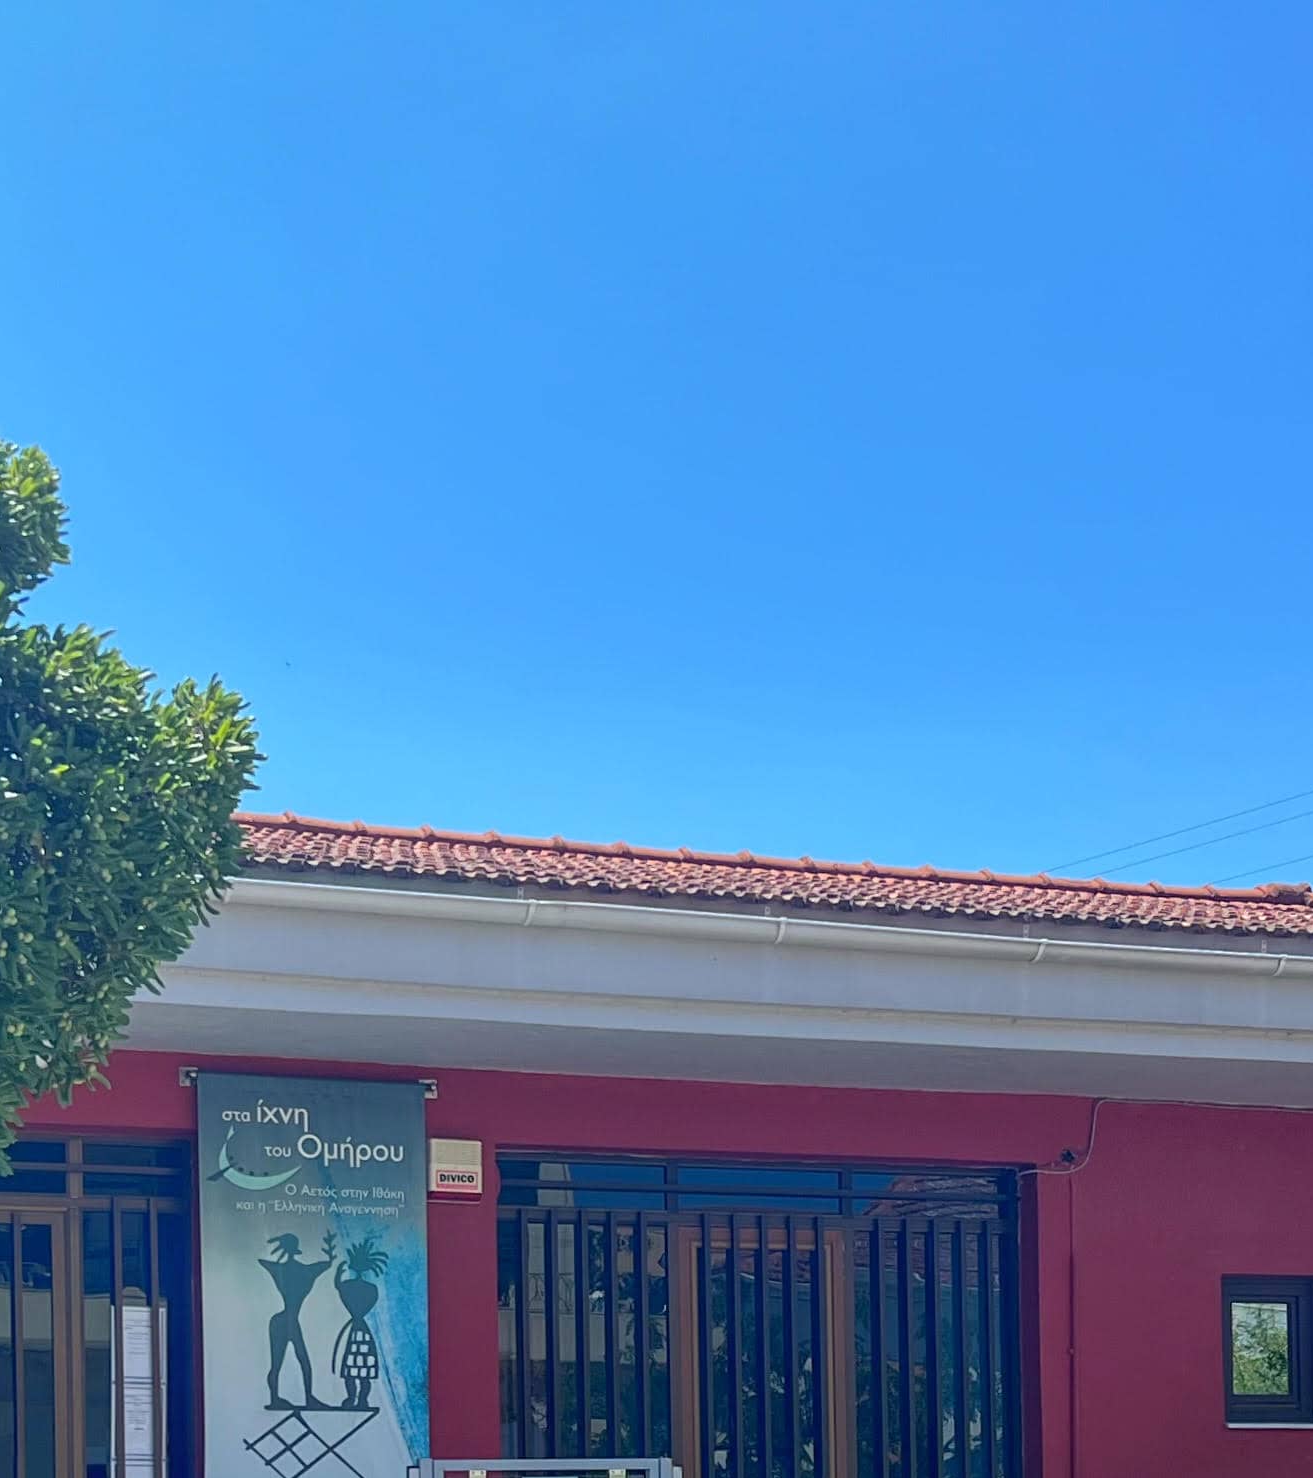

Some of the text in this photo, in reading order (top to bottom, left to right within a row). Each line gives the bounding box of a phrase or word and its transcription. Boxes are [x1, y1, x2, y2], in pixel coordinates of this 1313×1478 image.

[222, 1099, 308, 1132] στα ίχνη
[264, 1134, 404, 1168] του Ομήρου
[439, 1174, 475, 1183] DIVICO
[301, 1184, 337, 1198] Αετός
[341, 1188, 369, 1201] στην
[373, 1187, 405, 1201] Ιθάκη
[236, 1201, 255, 1211] και
[258, 1202, 266, 1213] η
